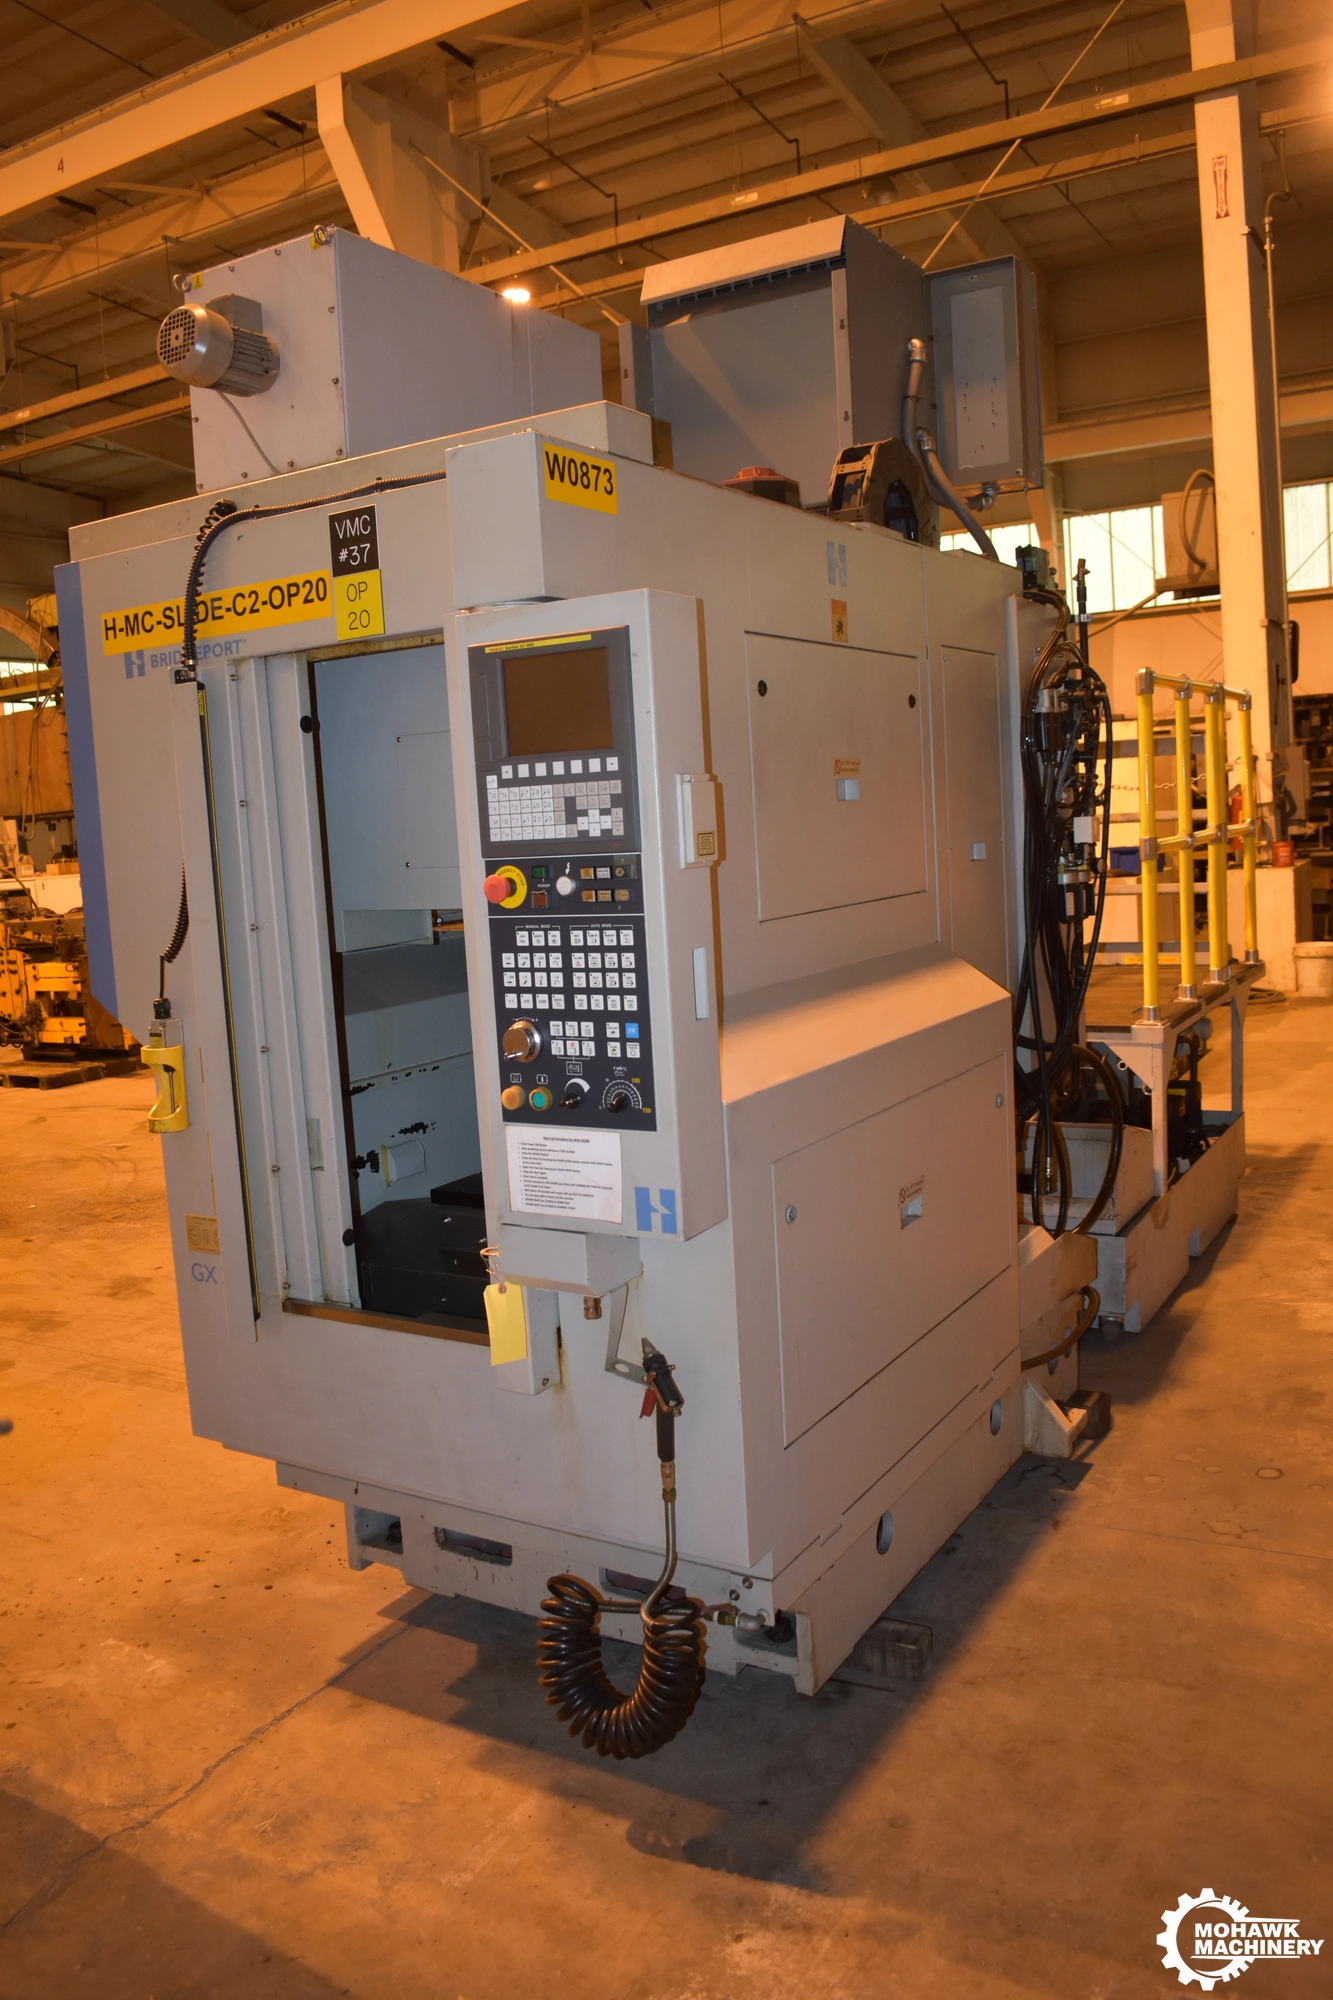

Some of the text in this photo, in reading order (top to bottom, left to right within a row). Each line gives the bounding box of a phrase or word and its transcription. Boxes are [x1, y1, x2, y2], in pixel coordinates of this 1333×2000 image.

[57, 157, 65, 173] 4
[544, 450, 614, 496] W0873
[334, 514, 371, 541] VMC
[339, 543, 371, 566] #37
[346, 581, 368, 603] OP
[104, 576, 328, 641] H-MC-SLDE-C2-OP20
[348, 609, 371, 631] 20
[150, 638, 243, 669] BRIDEPORT
[516, 872, 525, 886] STOP
[191, 1262, 218, 1286] GX
